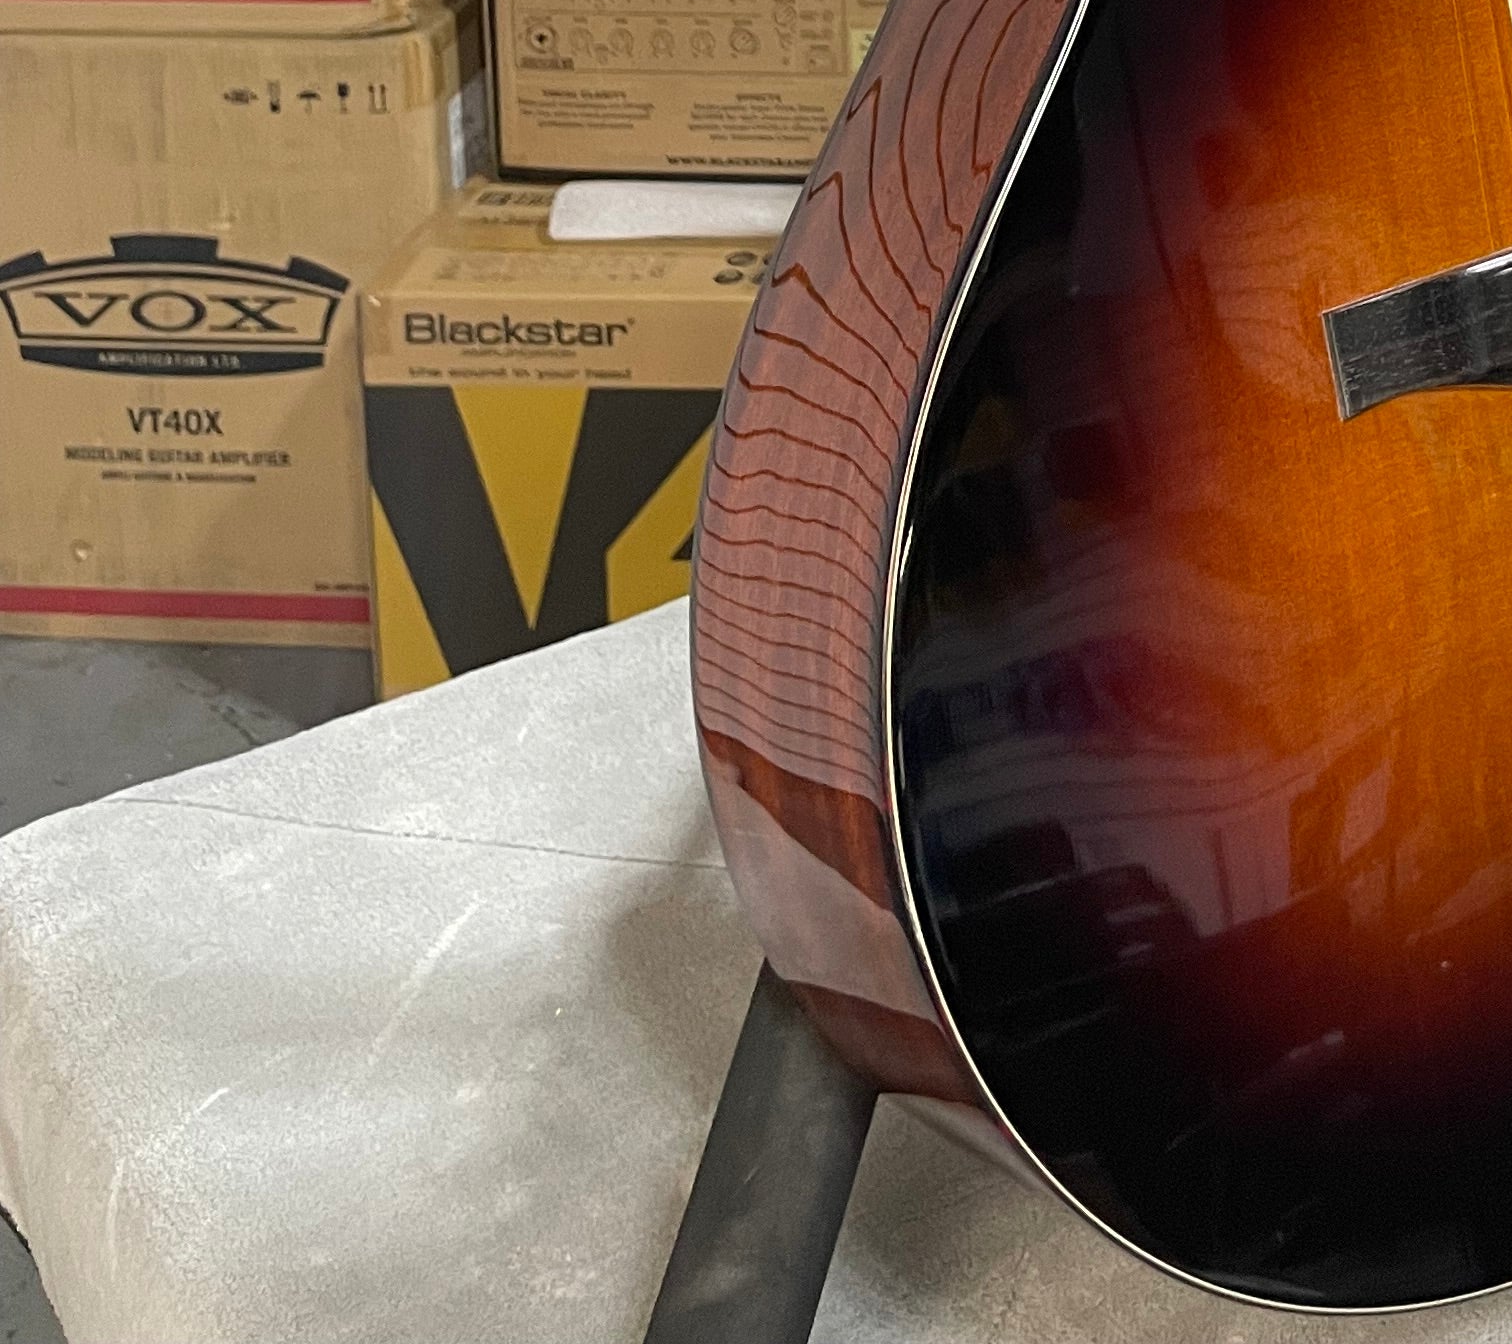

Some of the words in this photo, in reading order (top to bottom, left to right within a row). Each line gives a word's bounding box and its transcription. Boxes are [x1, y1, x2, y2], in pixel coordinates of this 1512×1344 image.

[34, 290, 297, 333] VOX
[404, 313, 629, 347] Blackstar
[127, 408, 224, 436] VT40X
[64, 446, 143, 462] MODELING
[149, 448, 203, 464] GUITAR
[210, 450, 291, 467] AMPLIFIER
